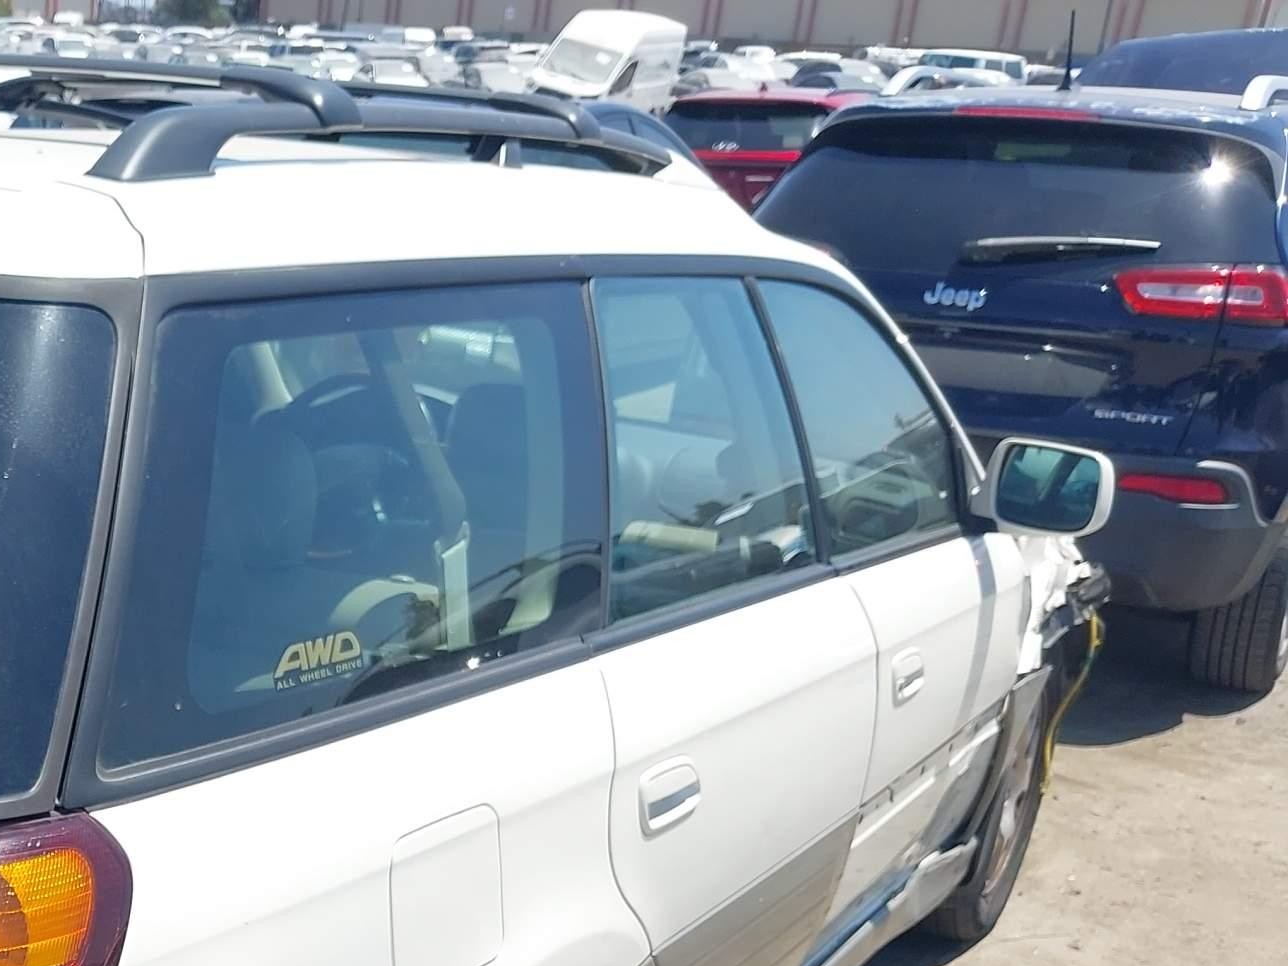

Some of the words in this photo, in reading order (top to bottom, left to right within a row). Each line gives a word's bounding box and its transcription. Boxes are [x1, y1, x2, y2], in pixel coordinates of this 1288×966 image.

[923, 281, 987, 312] Jeep
[1094, 408, 1175, 426] SPORT
[274, 631, 361, 678] AWD
[277, 678, 296, 691] ALL
[299, 669, 334, 683] WHEEL
[335, 659, 363, 674] DRIVE
